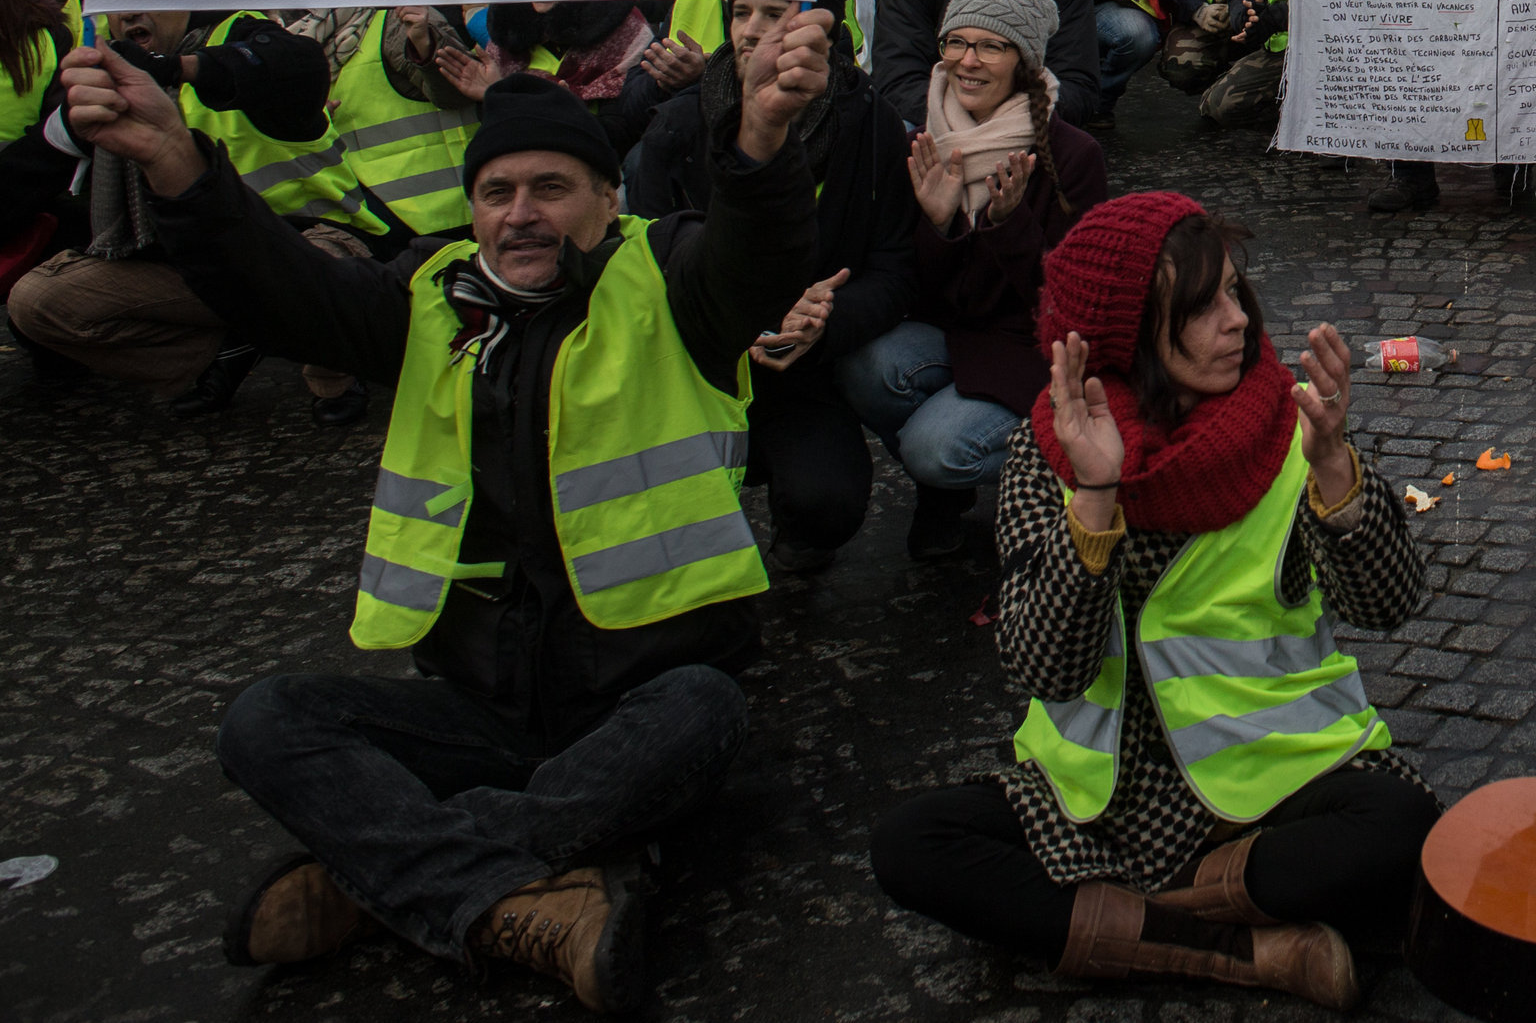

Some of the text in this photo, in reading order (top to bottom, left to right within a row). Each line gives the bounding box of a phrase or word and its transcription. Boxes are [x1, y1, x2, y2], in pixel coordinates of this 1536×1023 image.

[1345, 1, 1363, 9] VEUT
[1437, 3, 1474, 11] VACANCES
[1511, 3, 1530, 15] AUX
[1369, 35, 1383, 43] DU
[1429, 34, 1480, 42] CARBURANTS
[1325, 47, 1344, 55] NON
[1369, 75, 1392, 83] PLACE
[1508, 84, 1536, 96] STOP
[1391, 116, 1403, 124] DU
[1306, 136, 1368, 150] RETROUVER
[1375, 142, 1400, 150] NOTRE
[1441, 142, 1481, 153] D'ACHAT
[1520, 137, 1531, 146] ET
